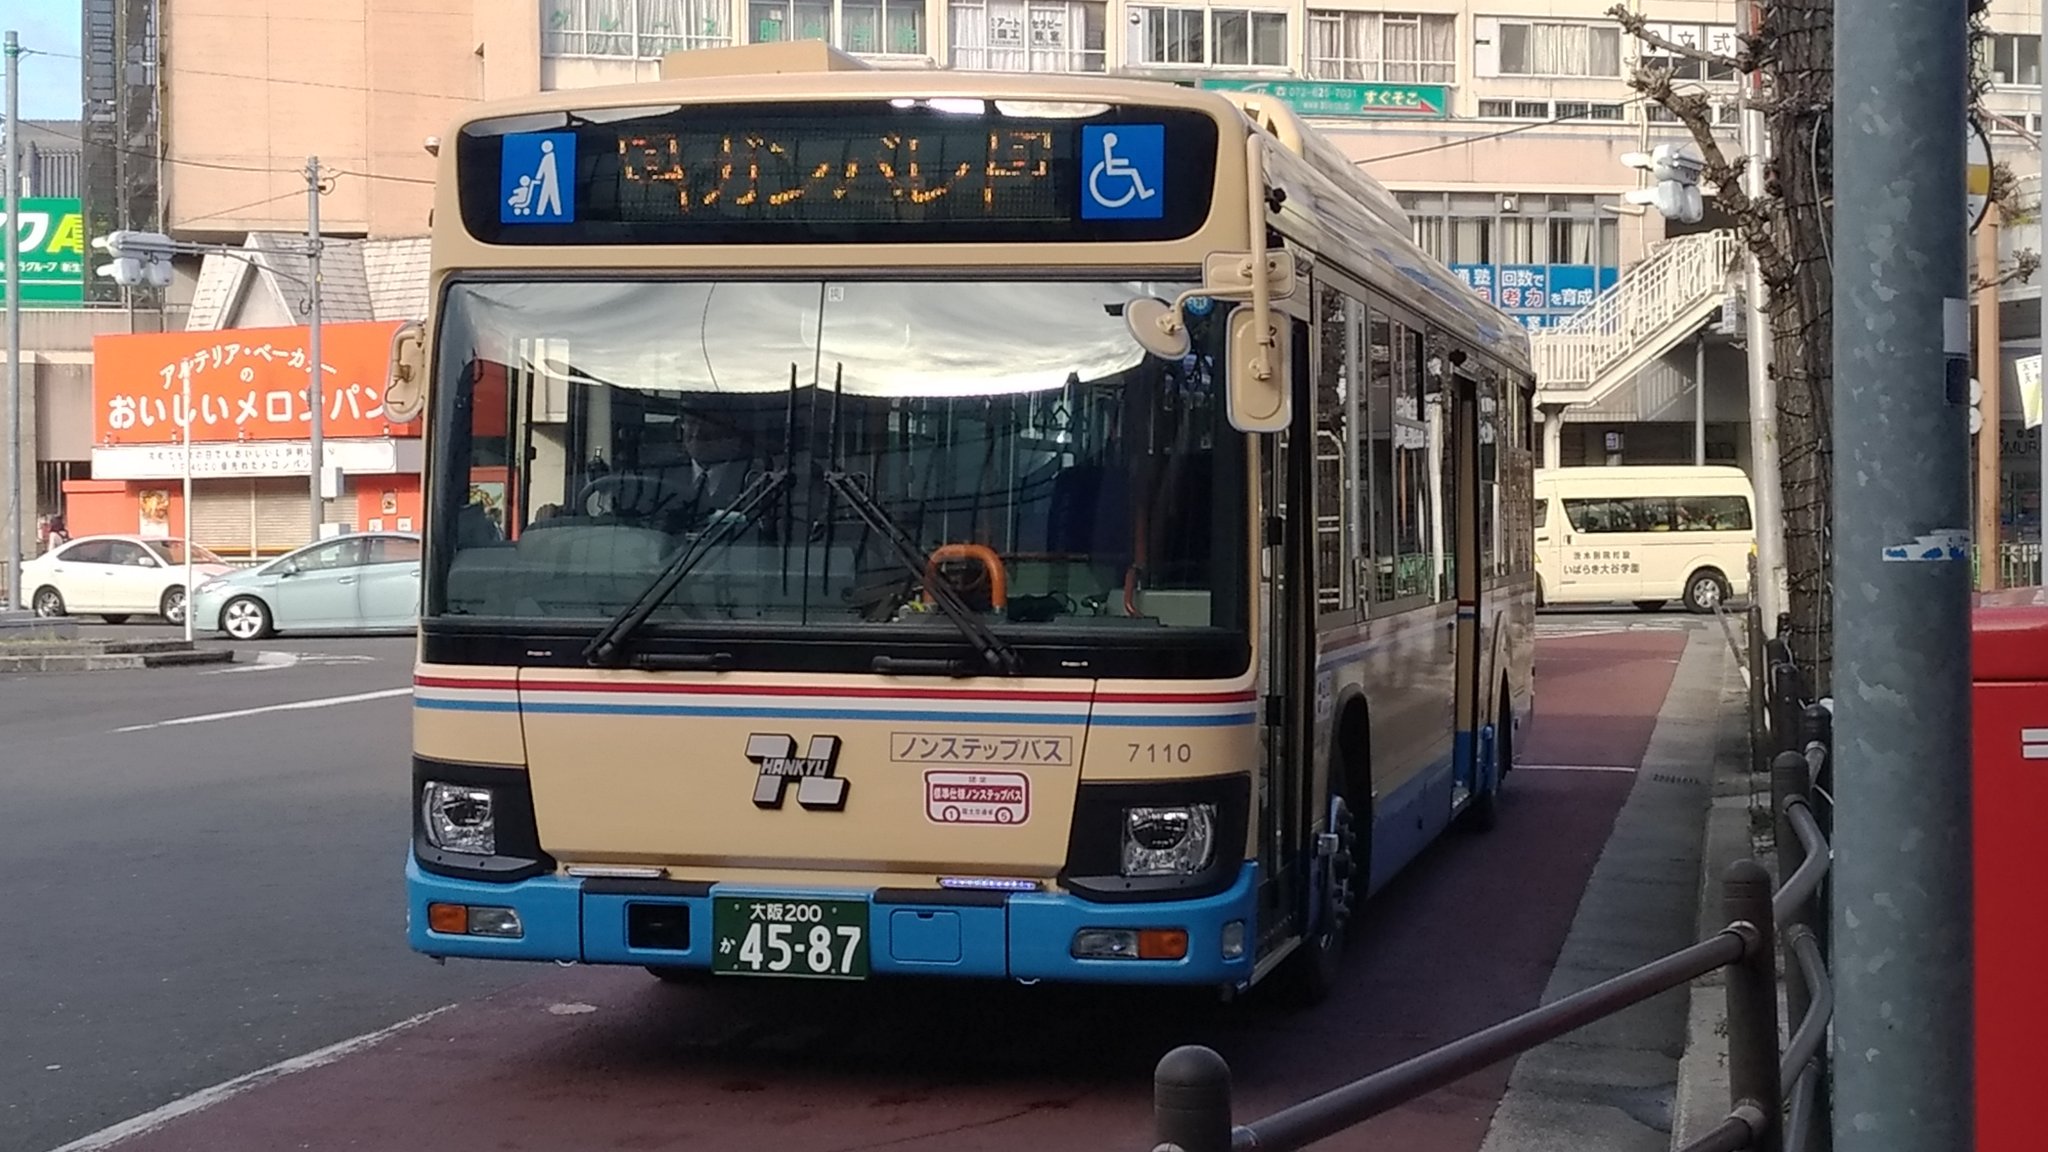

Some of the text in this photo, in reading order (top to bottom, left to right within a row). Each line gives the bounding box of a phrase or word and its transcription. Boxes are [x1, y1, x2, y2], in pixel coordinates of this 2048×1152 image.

[997, 17, 1020, 28] アート
[1031, 19, 1062, 29] セラピー
[1364, 89, 1420, 106] すぐそこ
[240, 367, 254, 382] の
[108, 383, 384, 429] おいしいメロンパン
[1563, 562, 1640, 575] いばらき大谷学園
[900, 736, 1063, 762] ノンステップバス
[1128, 743, 1191, 763] 7110
[761, 758, 829, 776] HANKYU
[933, 786, 1022, 802] 標準仕様ノンステップバス
[750, 903, 823, 923] 大阪200
[719, 922, 861, 974] か 45-87
